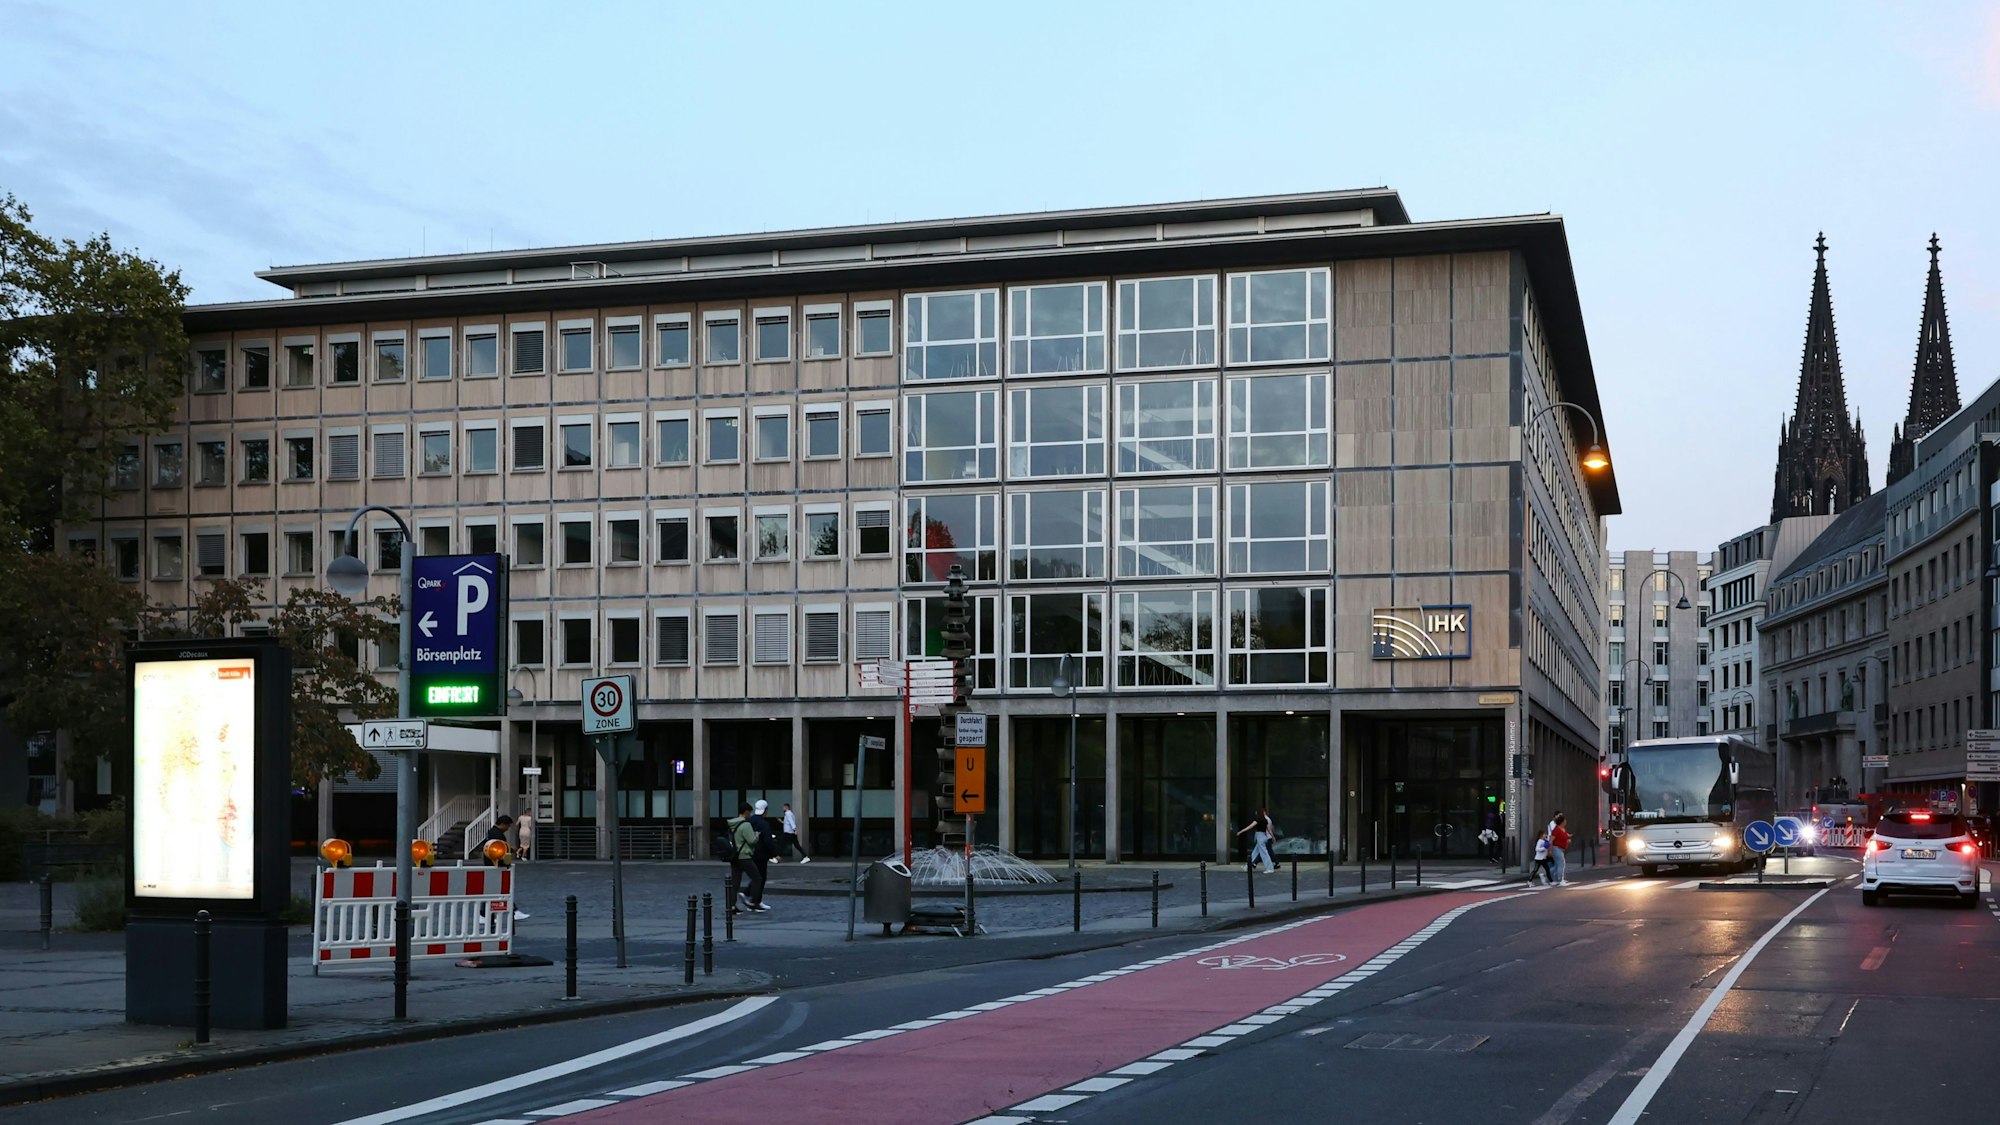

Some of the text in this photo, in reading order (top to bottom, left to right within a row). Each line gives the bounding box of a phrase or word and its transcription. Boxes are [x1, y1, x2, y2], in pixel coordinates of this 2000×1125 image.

[456, 574, 490, 636] P
[1428, 613, 1466, 633] IHK
[178, 651, 209, 659] JCDecaux
[416, 645, 482, 665] Börsenplatz
[597, 690, 616, 708] 30
[595, 718, 621, 729] ZONE
[960, 716, 983, 724] Durchfahrt
[958, 735, 984, 744] gesperrt
[966, 756, 974, 771] U
[1508, 796, 1516, 830] Industrie-
